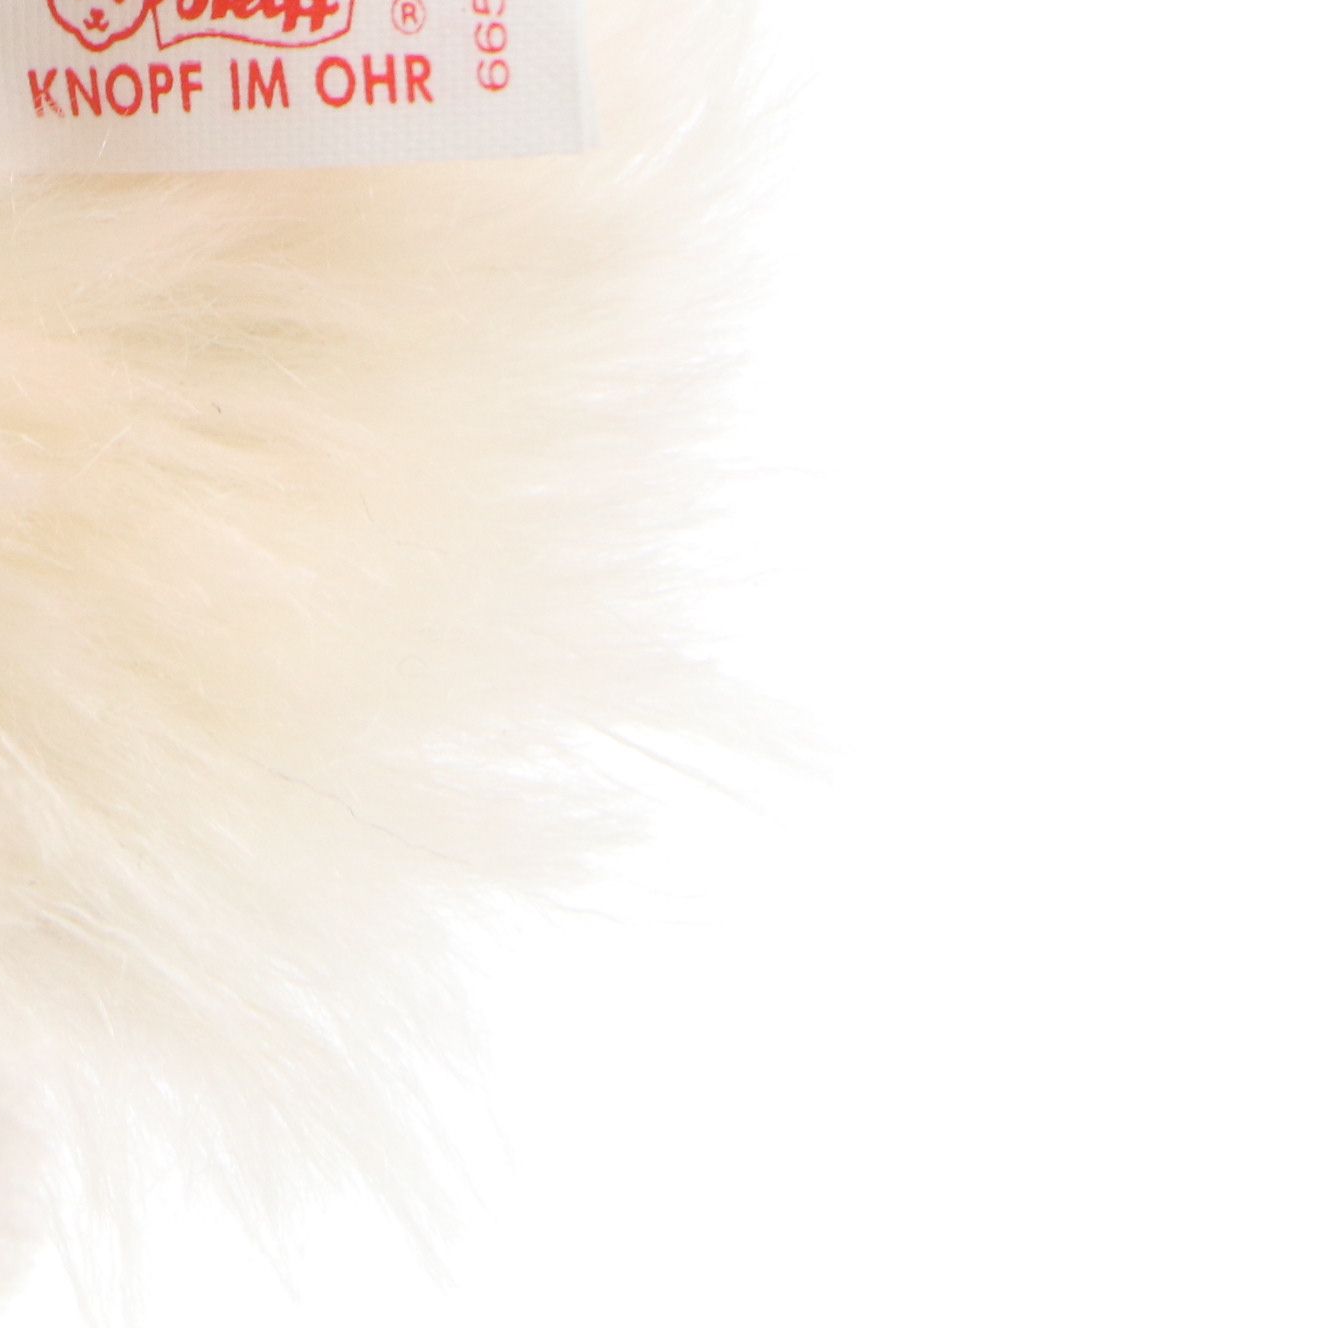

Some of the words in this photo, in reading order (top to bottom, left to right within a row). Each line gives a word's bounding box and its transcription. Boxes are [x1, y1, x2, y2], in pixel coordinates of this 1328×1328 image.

[26, 58, 206, 120] KNOPF
[227, 55, 292, 113] IM
[314, 51, 436, 110] OHR
